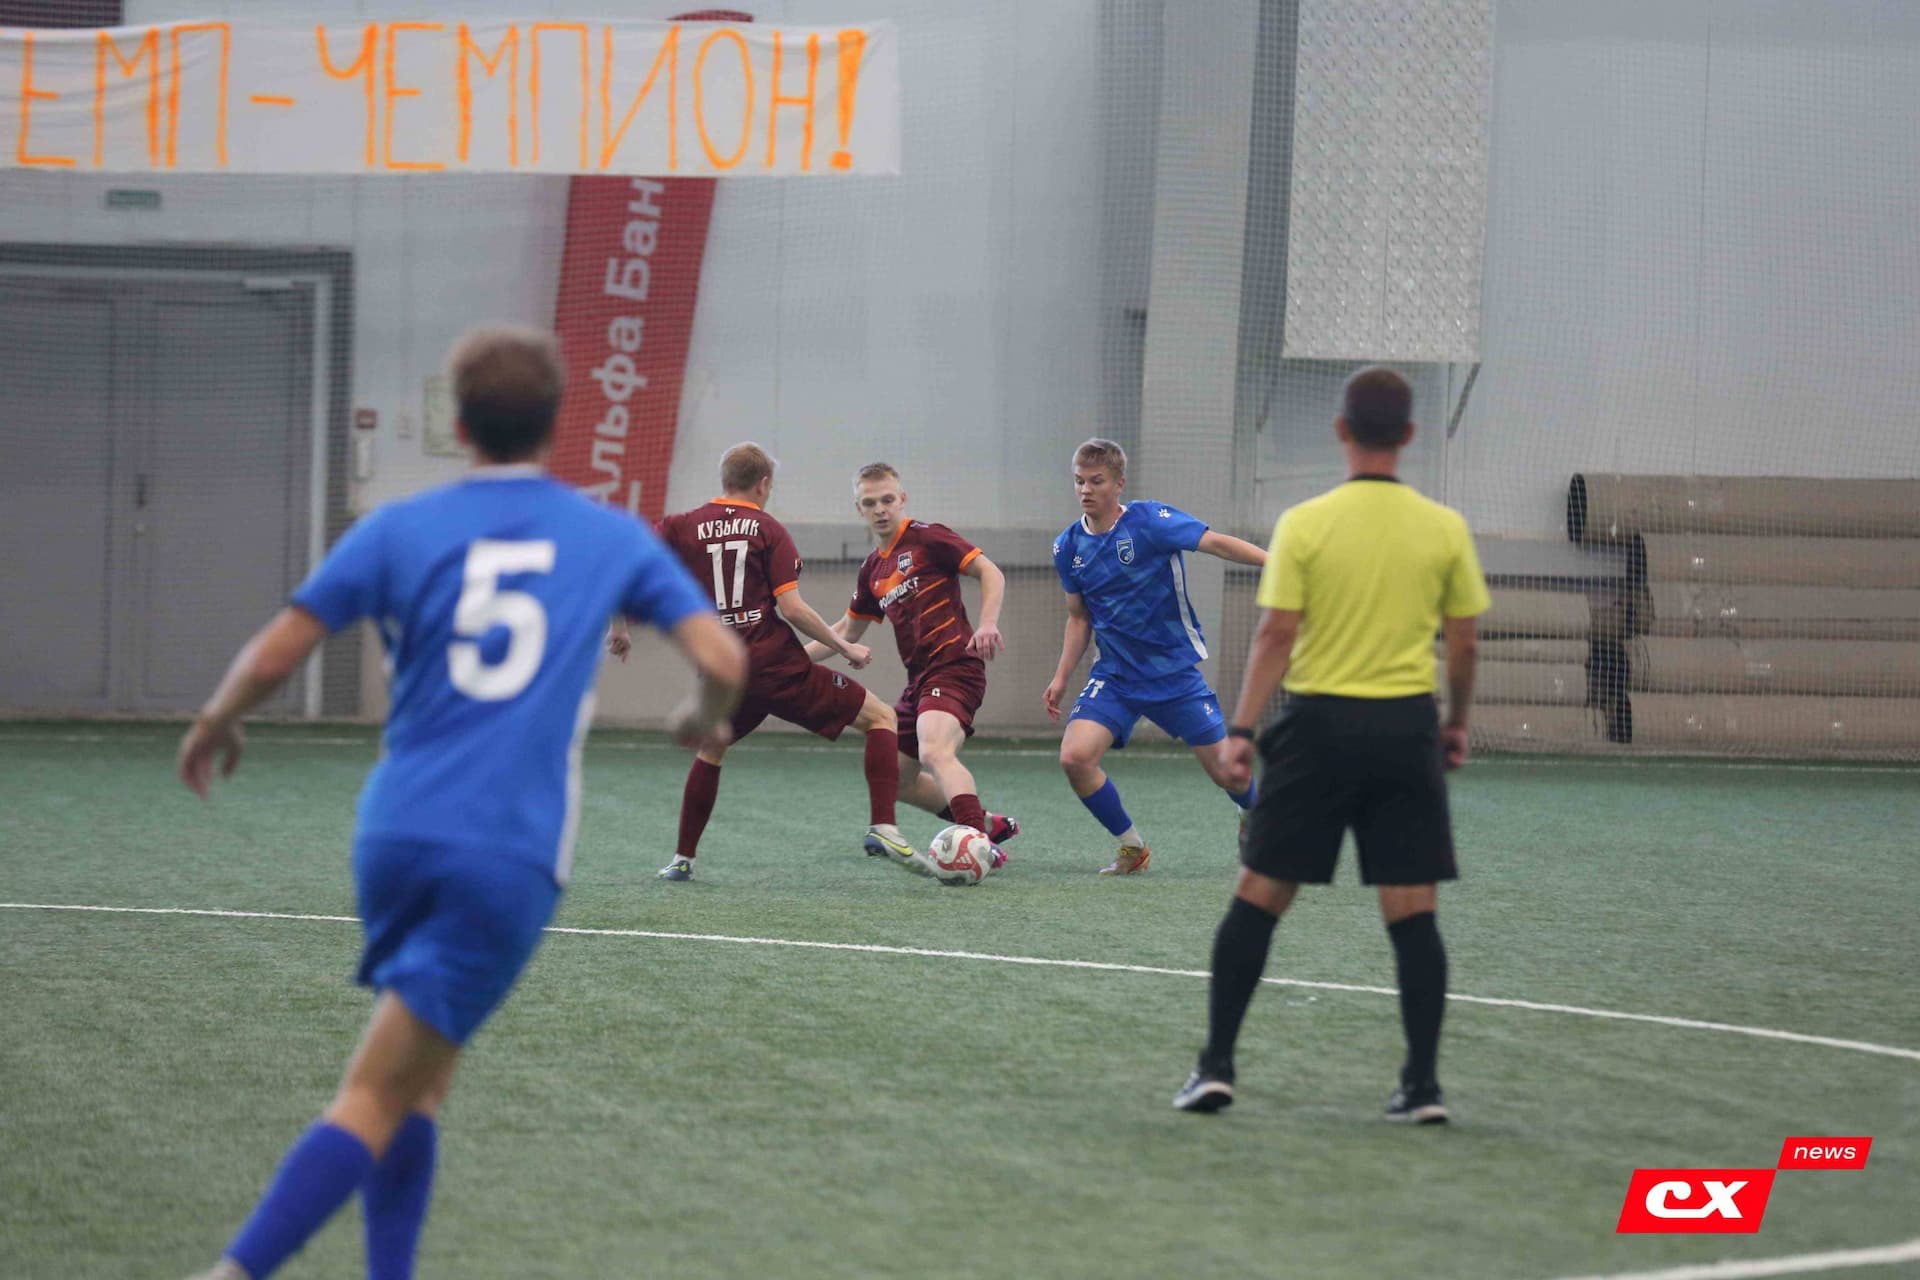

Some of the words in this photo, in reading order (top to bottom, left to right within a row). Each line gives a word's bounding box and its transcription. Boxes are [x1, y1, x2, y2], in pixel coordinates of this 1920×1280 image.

[315, 22, 867, 170] ЧЕМПИОН!
[447, 538, 557, 702] 5
[706, 540, 748, 610] 17
[715, 609, 762, 626] EUS
